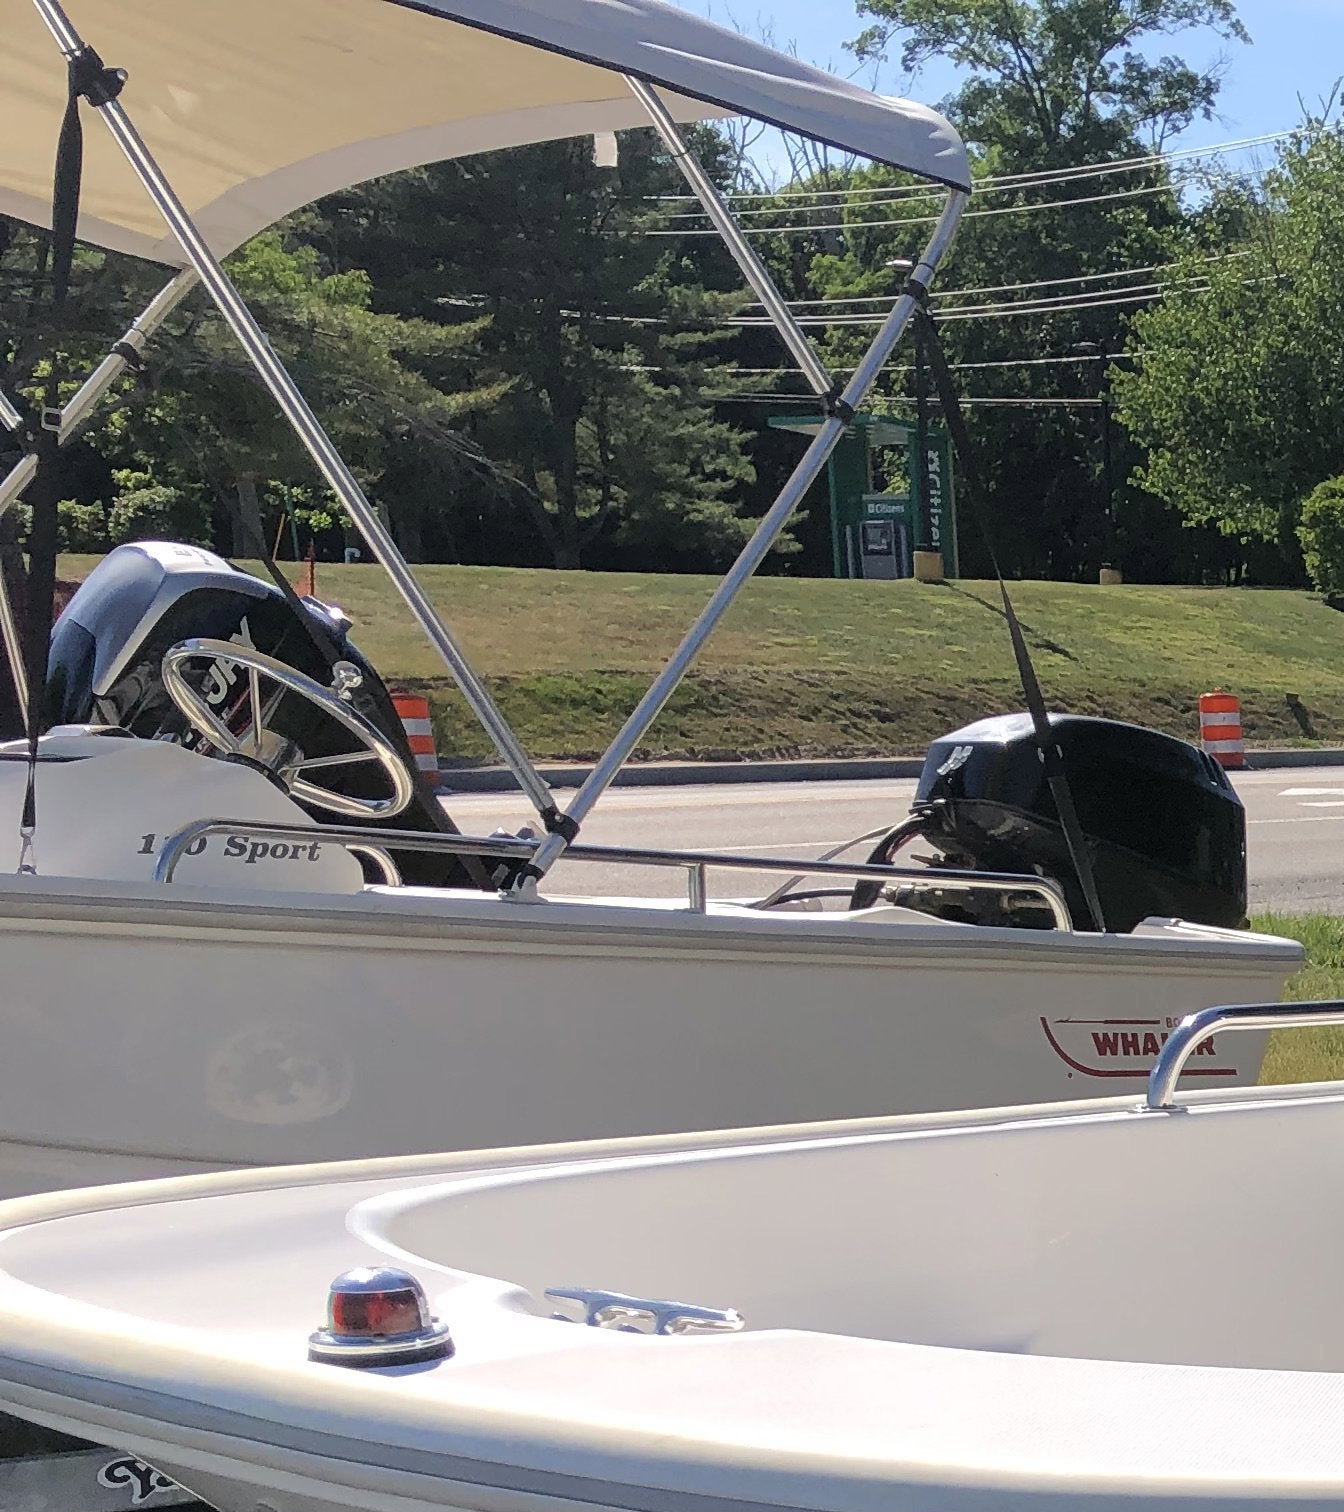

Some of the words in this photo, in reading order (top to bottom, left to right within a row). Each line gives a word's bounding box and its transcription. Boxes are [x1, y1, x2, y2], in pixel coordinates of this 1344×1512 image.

[137, 833, 208, 856] 10
[223, 834, 322, 864] Sport
[1091, 1031, 1217, 1057] WHAR
